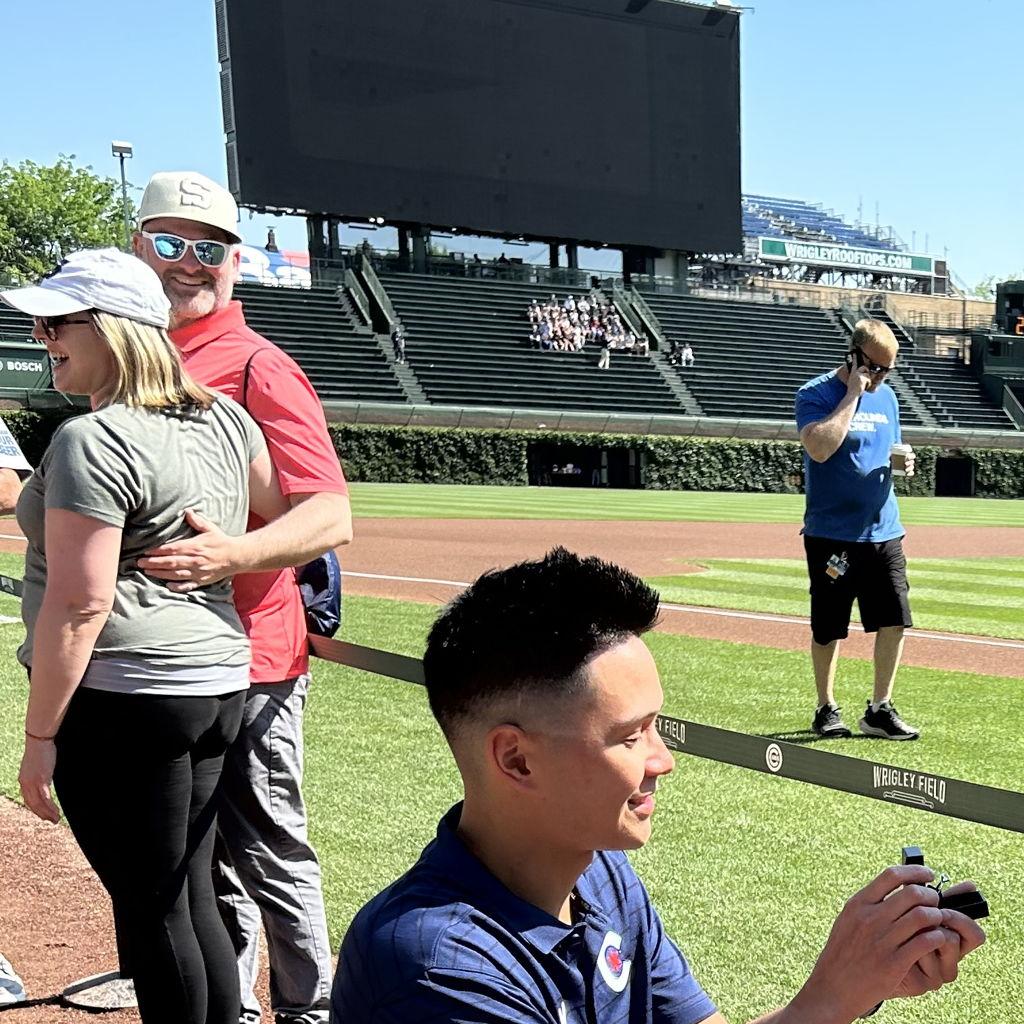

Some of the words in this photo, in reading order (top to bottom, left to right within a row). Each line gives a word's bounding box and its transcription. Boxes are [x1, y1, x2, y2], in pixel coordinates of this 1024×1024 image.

[785, 243, 912, 269] WRIGLEYROOFTOPS.COM
[7, 361, 43, 372] BOSCH
[665, 719, 687, 744] FIELD
[873, 766, 916, 790] WRIGLEY
[918, 775, 946, 804] FIELD
